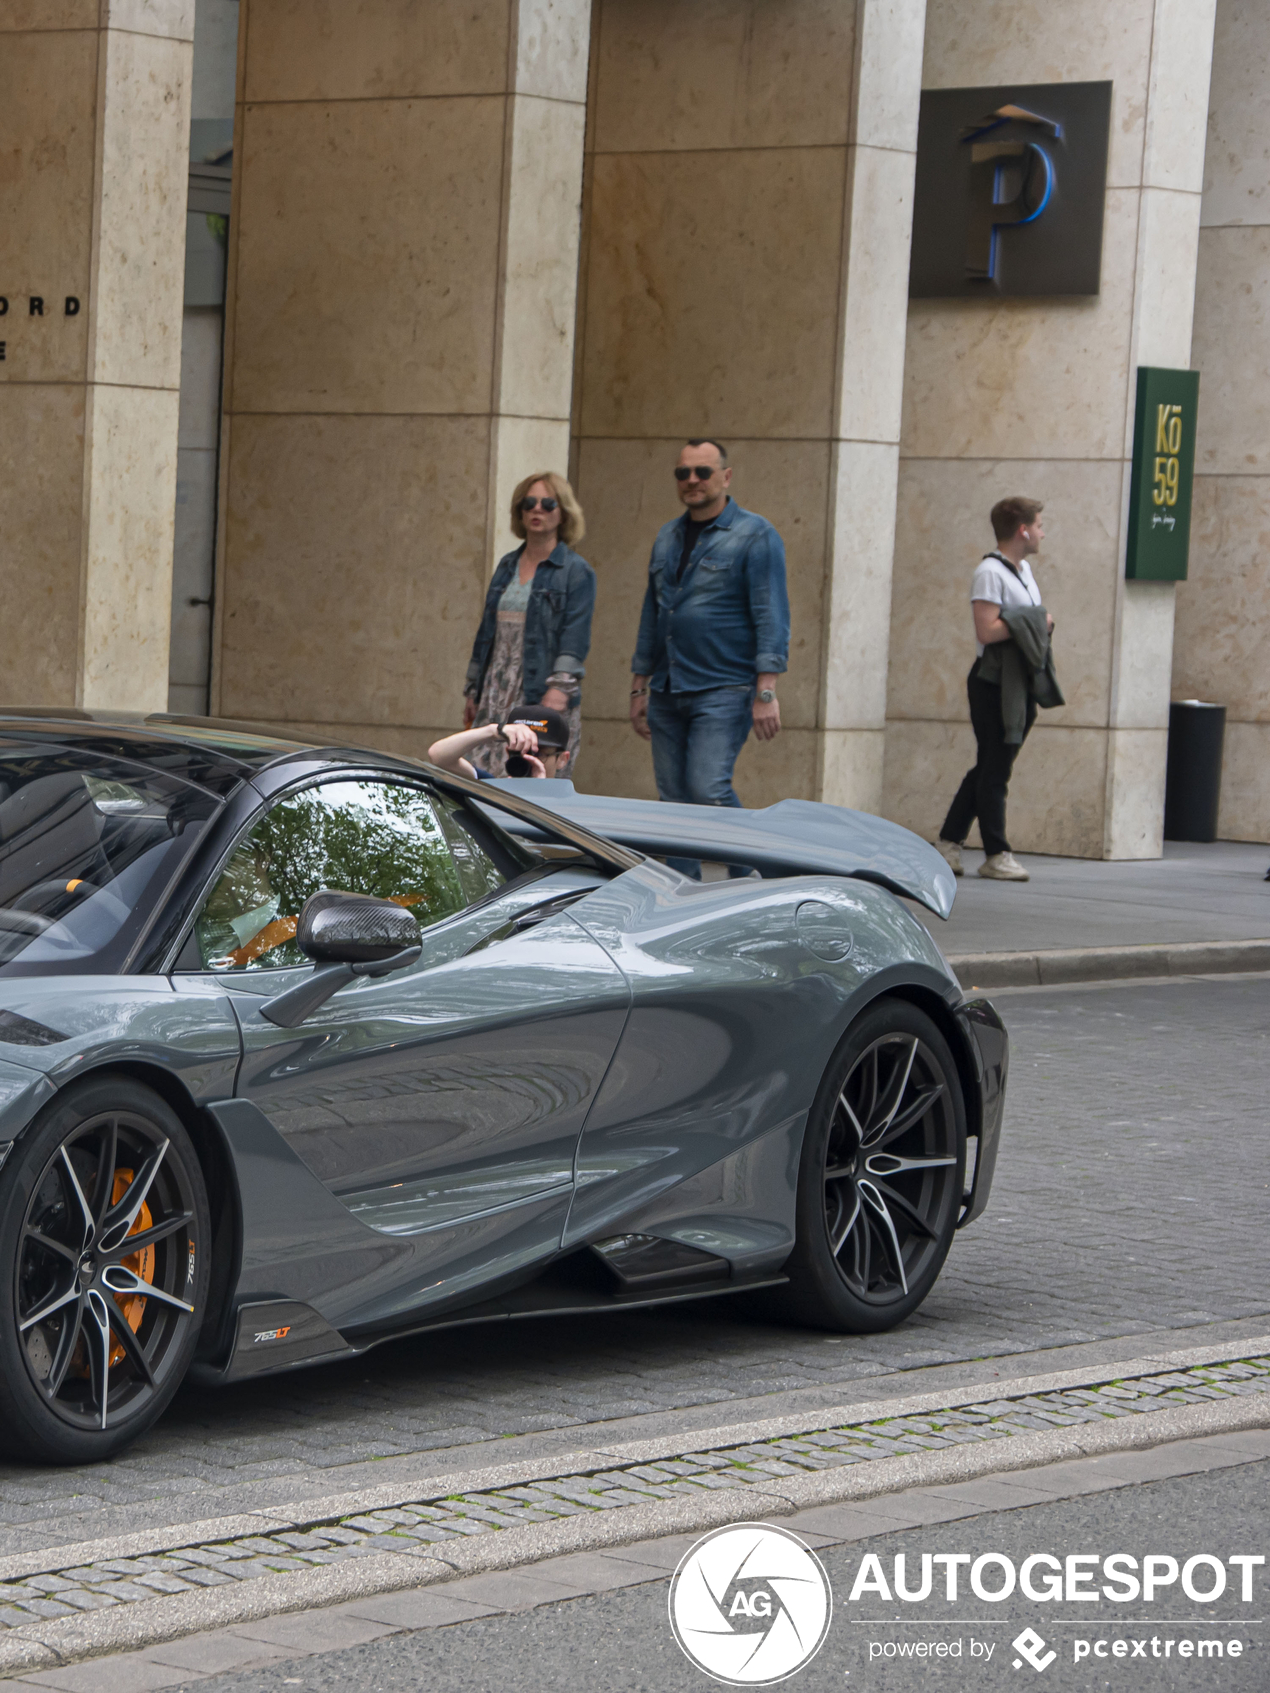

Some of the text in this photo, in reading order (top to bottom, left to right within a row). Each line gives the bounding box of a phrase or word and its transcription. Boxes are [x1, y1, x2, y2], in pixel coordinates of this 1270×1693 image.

[965, 141, 1058, 279] P
[1155, 404, 1183, 455] Kö
[1152, 457, 1180, 506] 59
[186, 1239, 196, 1285] 765LT
[255, 1327, 290, 1342] 765LT
